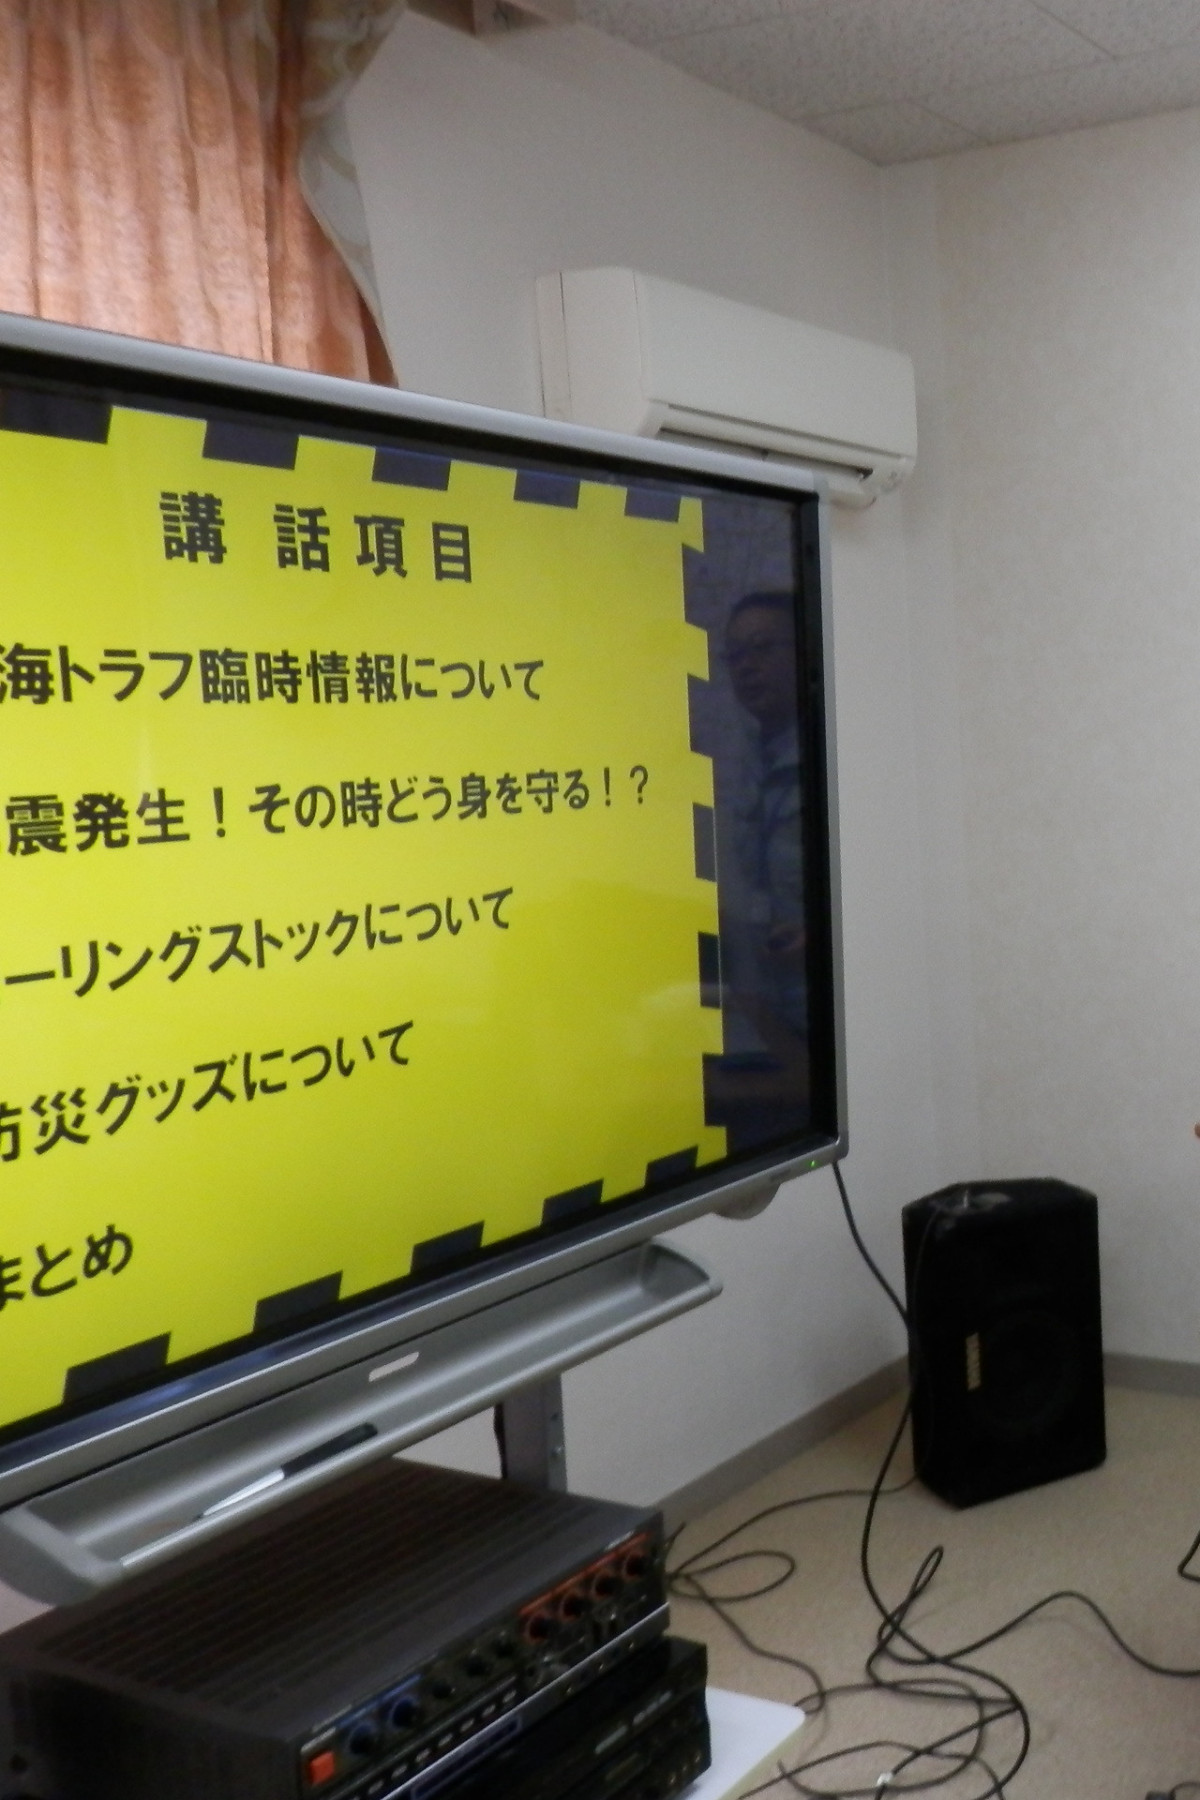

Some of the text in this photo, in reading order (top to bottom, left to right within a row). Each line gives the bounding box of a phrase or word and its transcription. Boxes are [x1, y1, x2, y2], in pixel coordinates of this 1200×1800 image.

[0, 641, 546, 706] 海トラフ臨時情報について
